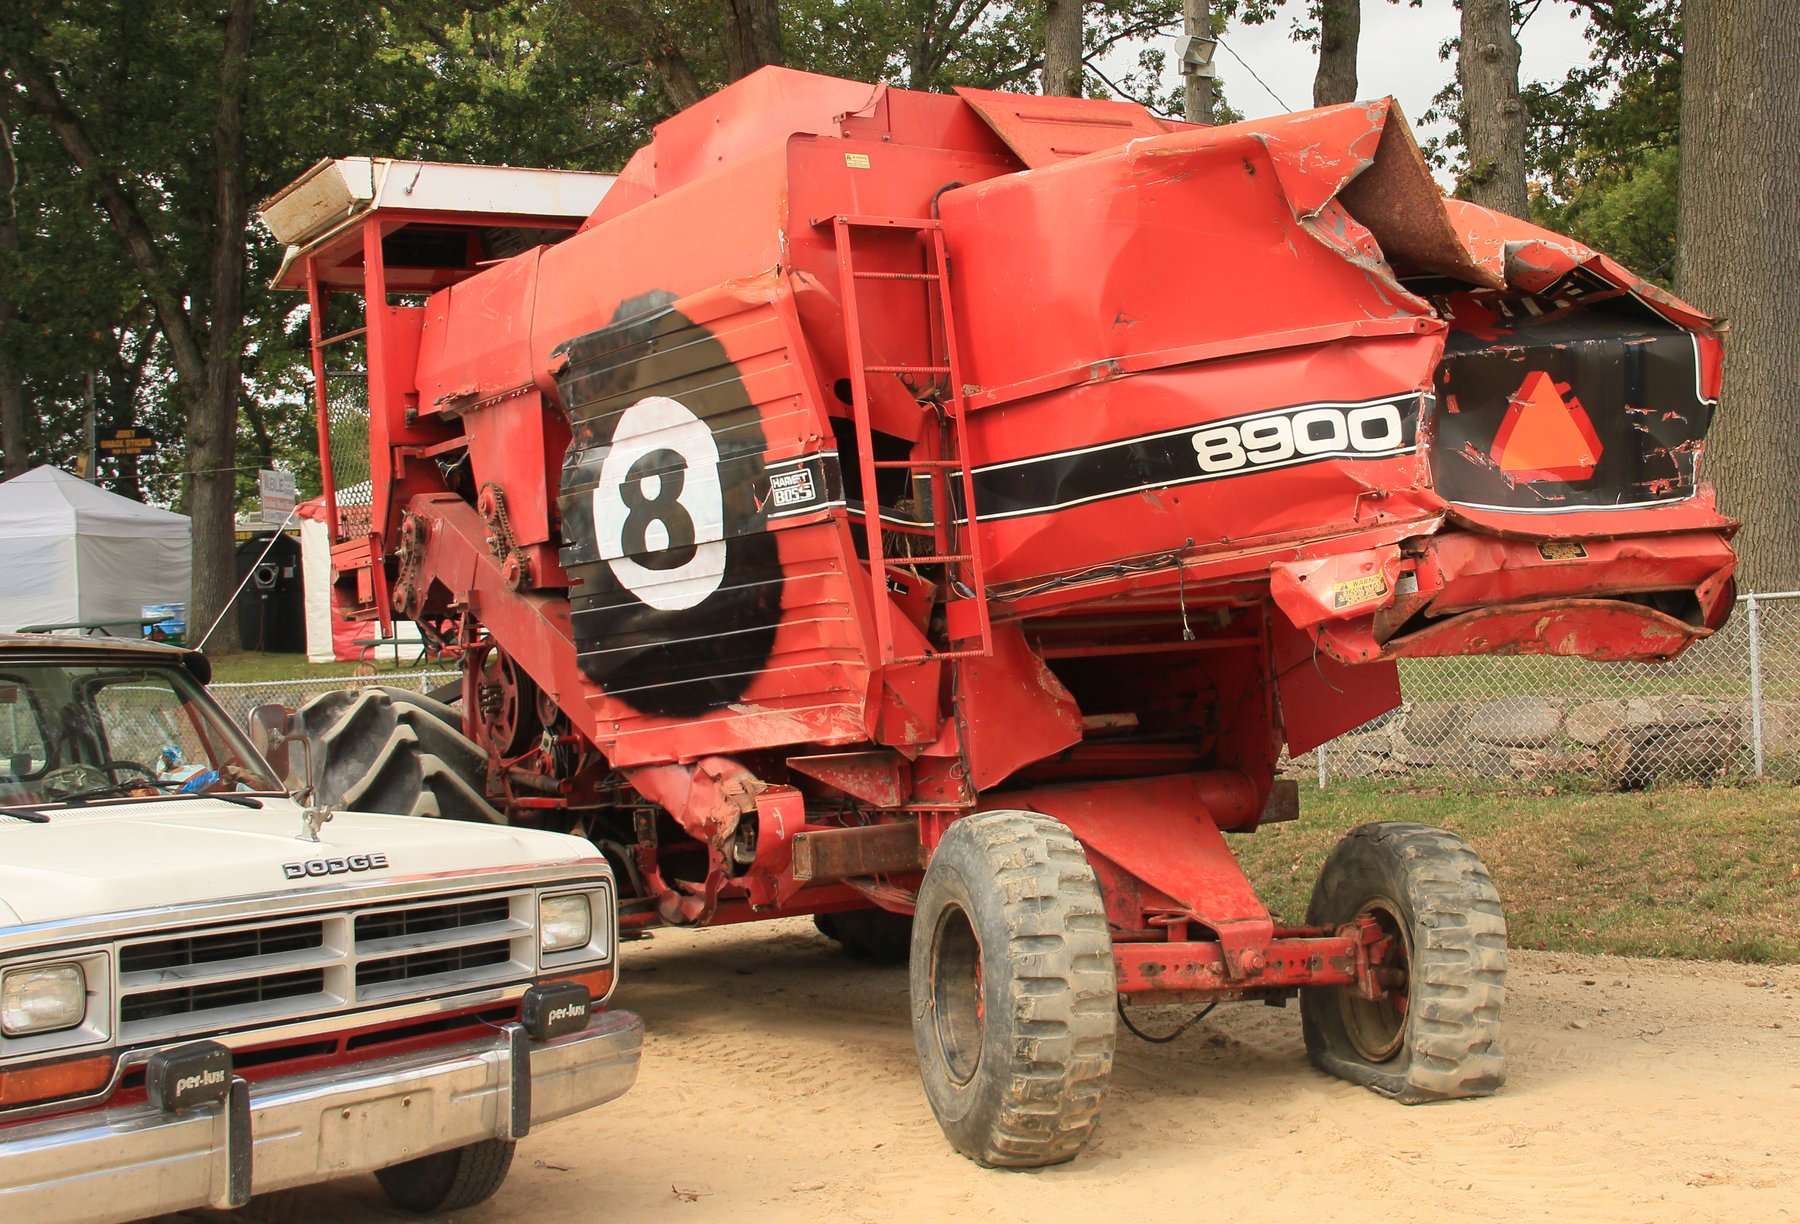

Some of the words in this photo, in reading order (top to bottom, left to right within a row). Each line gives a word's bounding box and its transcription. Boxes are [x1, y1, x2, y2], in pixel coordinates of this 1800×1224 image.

[1191, 404, 1403, 472] 8900
[774, 485, 813, 504] BOSS
[618, 448, 698, 571] 8
[281, 852, 389, 880] DODGE
[548, 1004, 586, 1026] per-lux
[176, 1069, 225, 1097] per-lux
